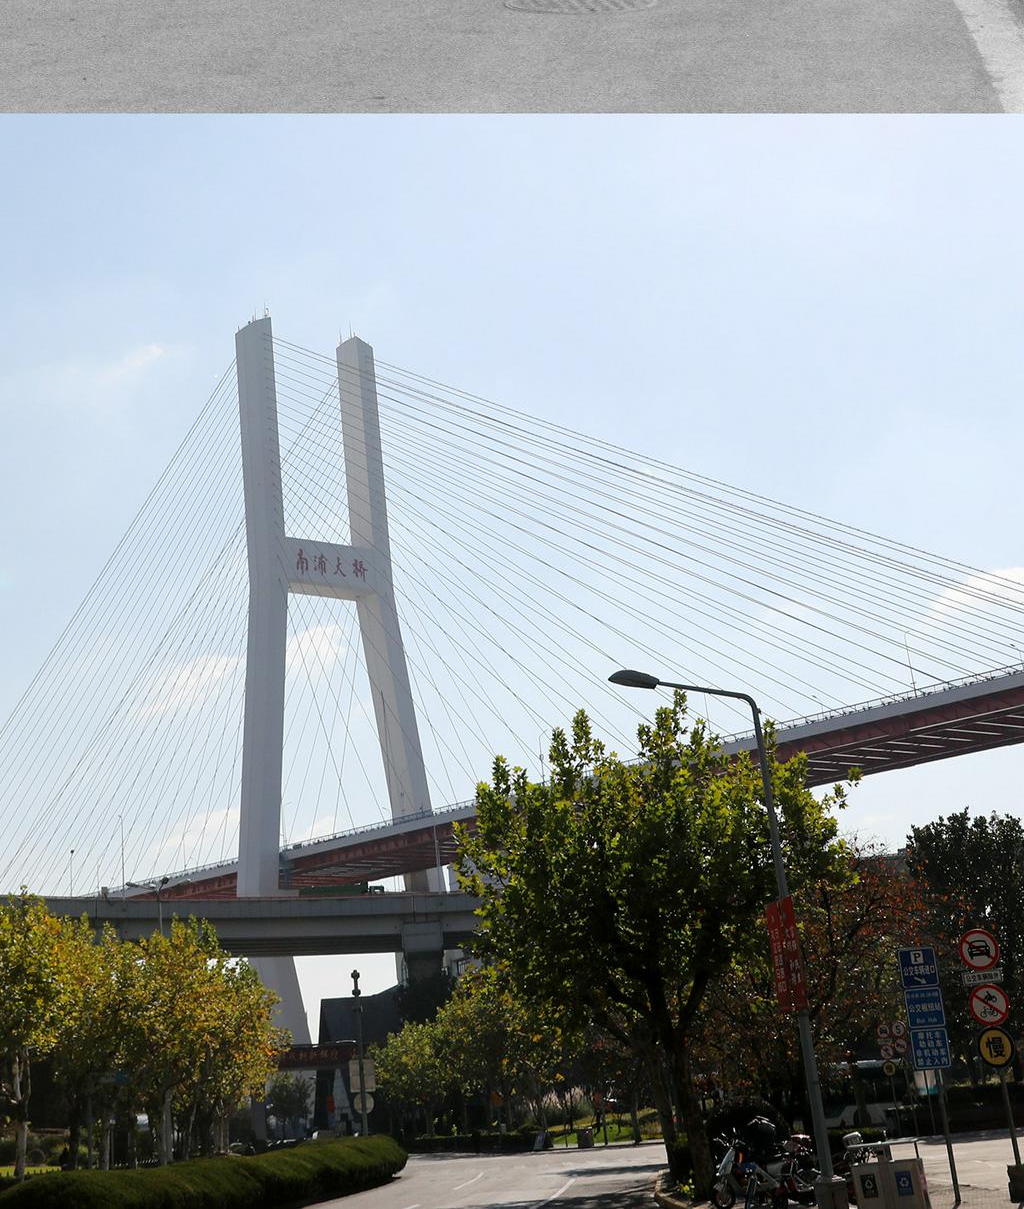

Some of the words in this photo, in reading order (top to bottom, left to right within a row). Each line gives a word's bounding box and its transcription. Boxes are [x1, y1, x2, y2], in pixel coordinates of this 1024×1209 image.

[296, 549, 368, 582] 南浦大桥
[913, 952, 921, 962] P
[986, 1037, 1006, 1058] 慢
